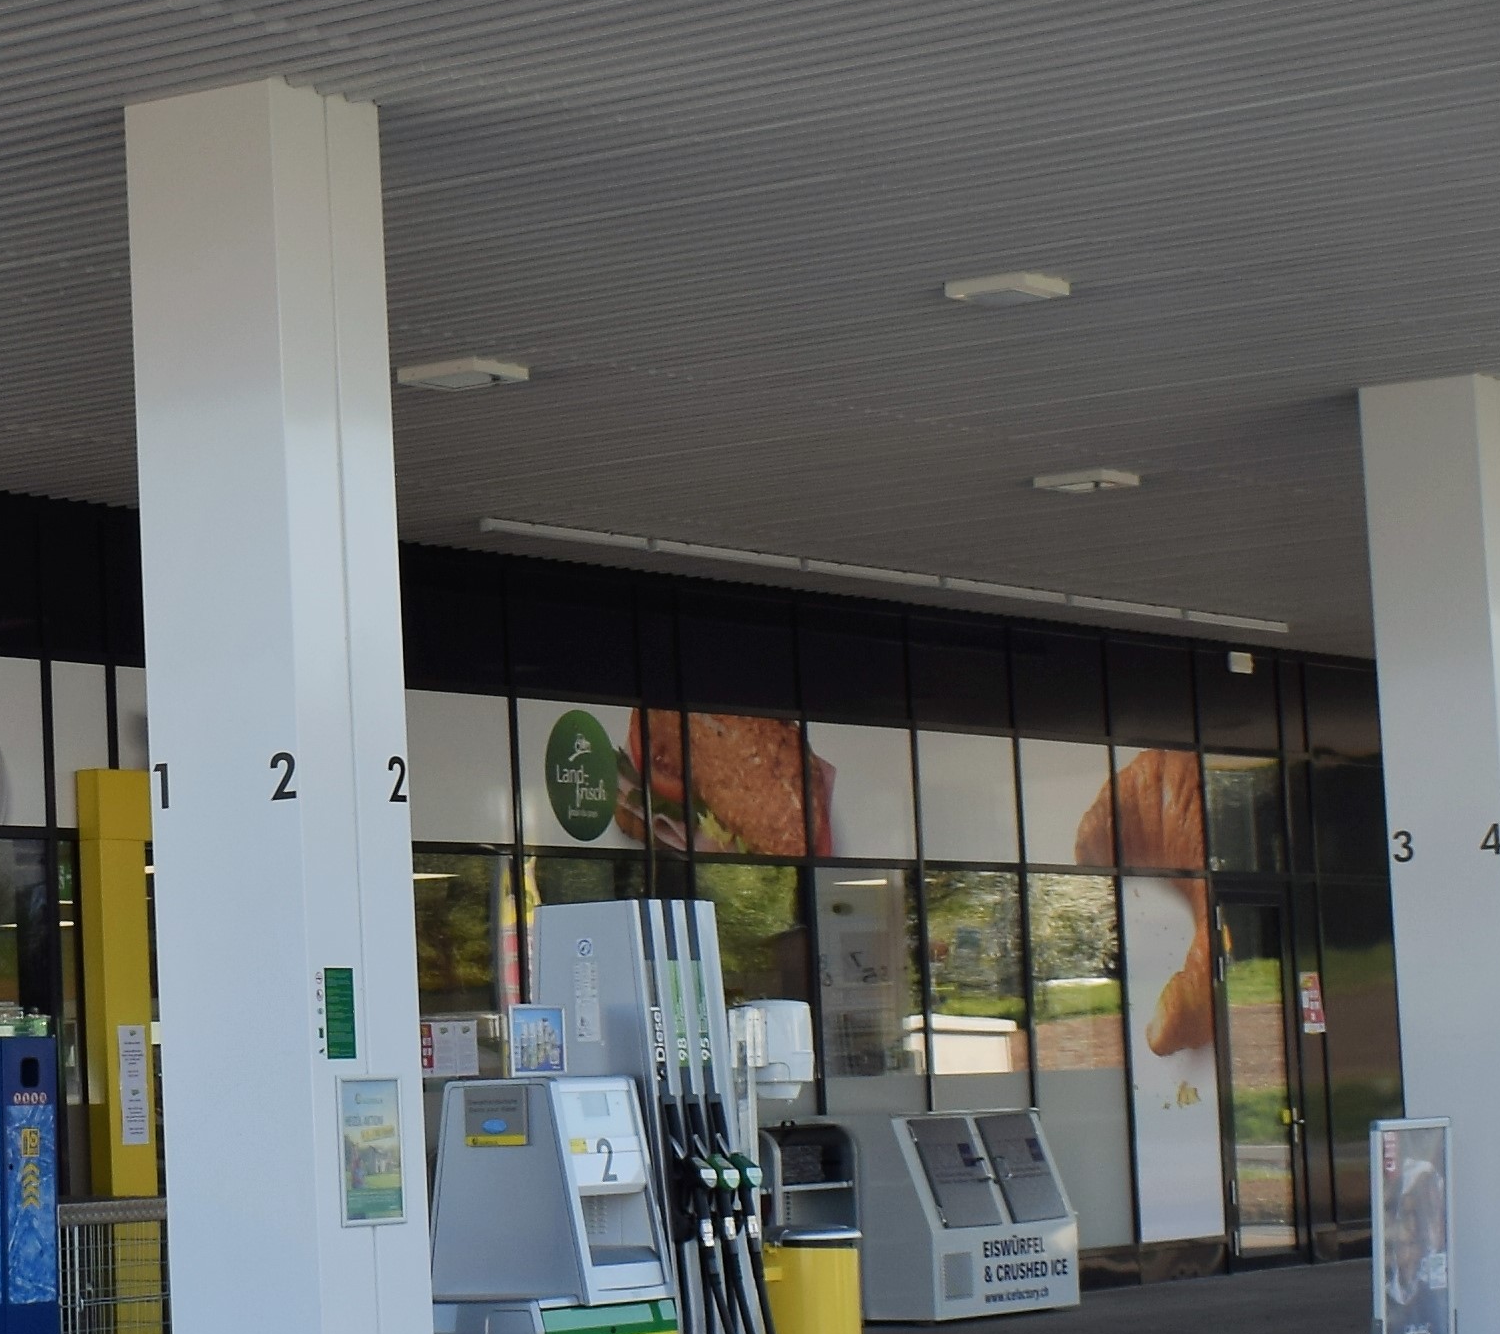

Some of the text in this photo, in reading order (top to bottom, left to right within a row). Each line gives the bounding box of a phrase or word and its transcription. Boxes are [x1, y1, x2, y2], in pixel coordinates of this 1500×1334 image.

[152, 762, 169, 809] 1
[269, 751, 297, 801] 2
[387, 755, 407, 803] 2
[1392, 830, 1414, 863] 3
[650, 1006, 666, 1063] Diesel
[677, 1037, 688, 1061] 98
[700, 1037, 711, 1061] 95
[596, 1137, 618, 1182] 2
[983, 1235, 1046, 1258] EISWÜRFEL
[984, 1257, 1069, 1283] & CRUSHED ICE
